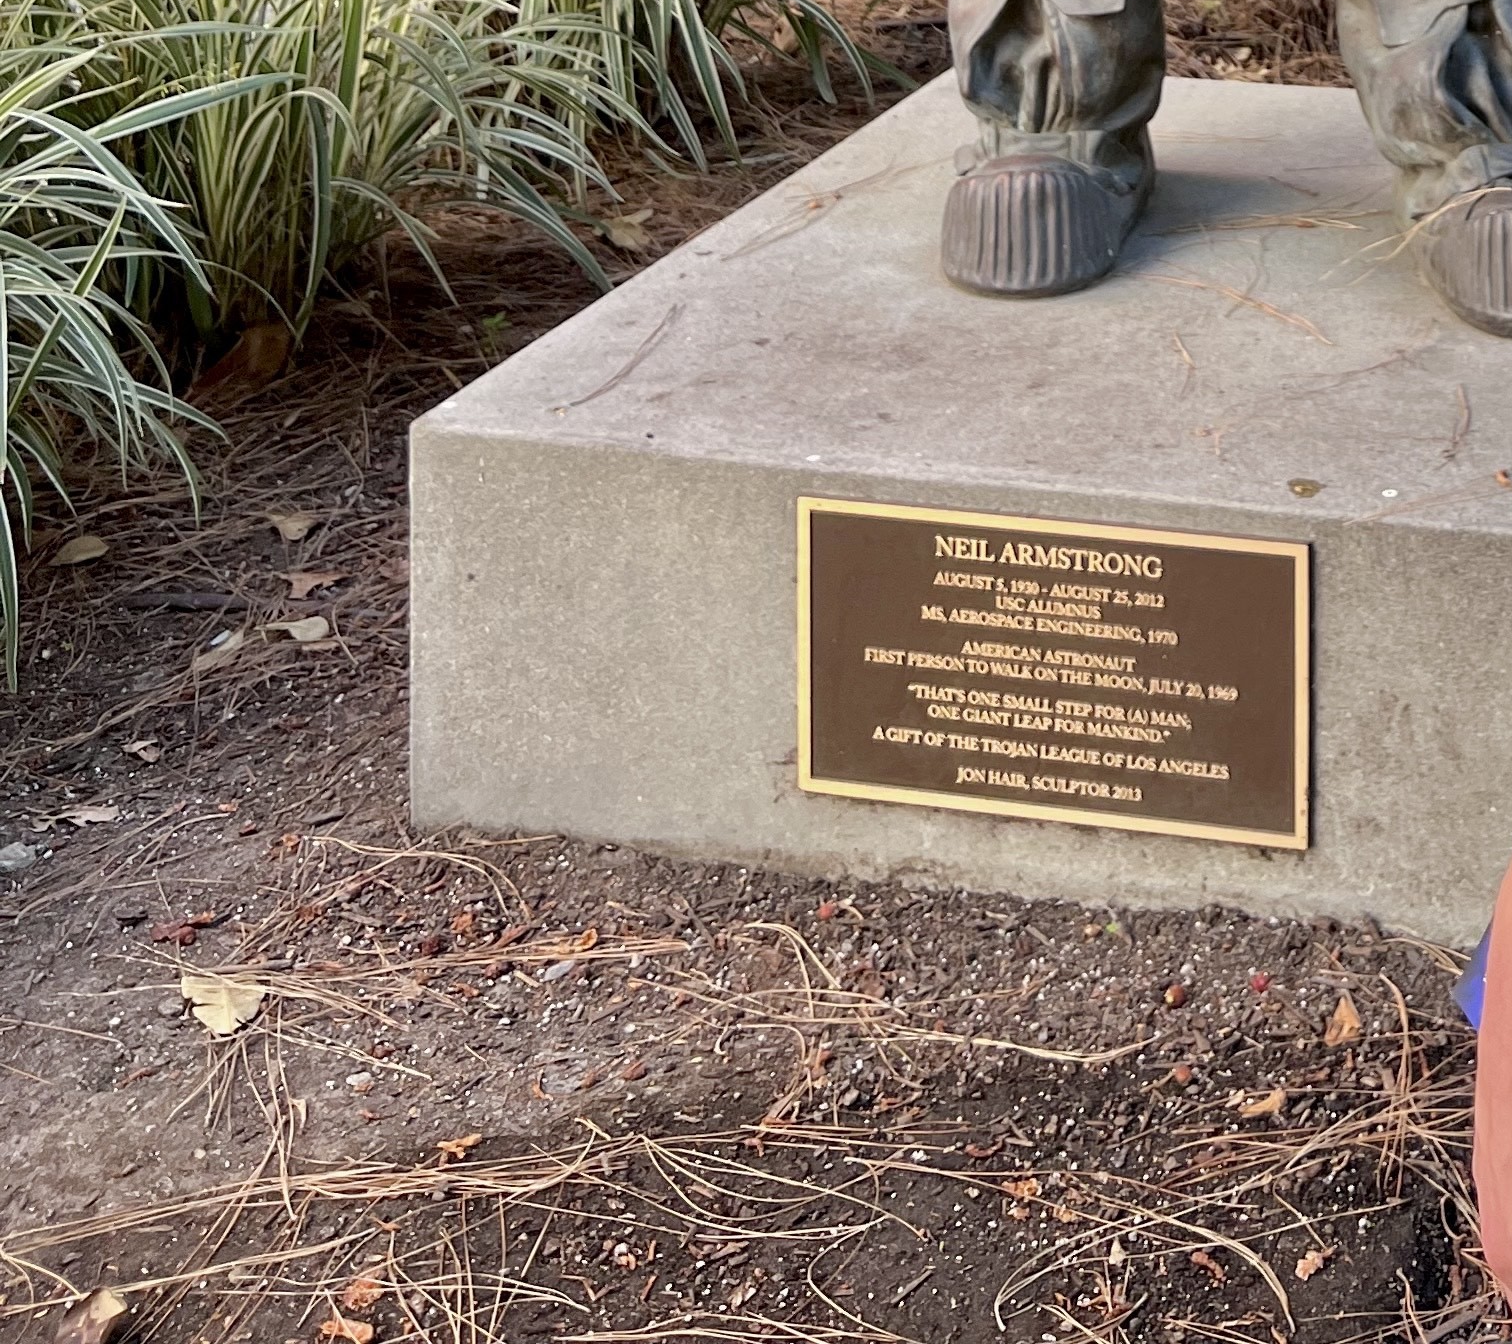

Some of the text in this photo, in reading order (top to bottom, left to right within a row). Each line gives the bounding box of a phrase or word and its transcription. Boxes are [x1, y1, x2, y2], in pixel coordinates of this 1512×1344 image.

[934, 535, 1164, 579] NEIL ARMSTRONG
[932, 570, 994, 590] AUGUST
[994, 576, 1008, 593] 5,
[1009, 578, 1040, 595] 1930
[1048, 582, 1112, 602] AUGUST
[1112, 588, 1133, 607] 25,
[1134, 590, 1165, 608] 2012
[995, 595, 1101, 619] USC ALUMNUS
[920, 605, 1179, 646] MS, AEROSPACE ENGINEERING, 1970
[864, 647, 1239, 701] FIRST PERSON TO WALK ON THE MOON, JULY 20, 1969
[960, 639, 1137, 673] AMERICAN ASTRONAUT
[926, 703, 960, 721] ONE
[961, 707, 1012, 727] GIANT
[1012, 712, 1053, 731] LEAP
[1053, 717, 1087, 735] FOR
[967, 690, 1000, 707] ONE
[1001, 693, 1053, 713] SMALL
[1054, 699, 1093, 717] STEP
[1093, 703, 1126, 721] FOR
[1126, 707, 1149, 726] (A)
[871, 725, 1230, 780] A GIFT OF THE TROJAN LEAGUE OF LOS ANGELES
[954, 766, 1143, 802] JON HAIR, SCULPTOR 2013
